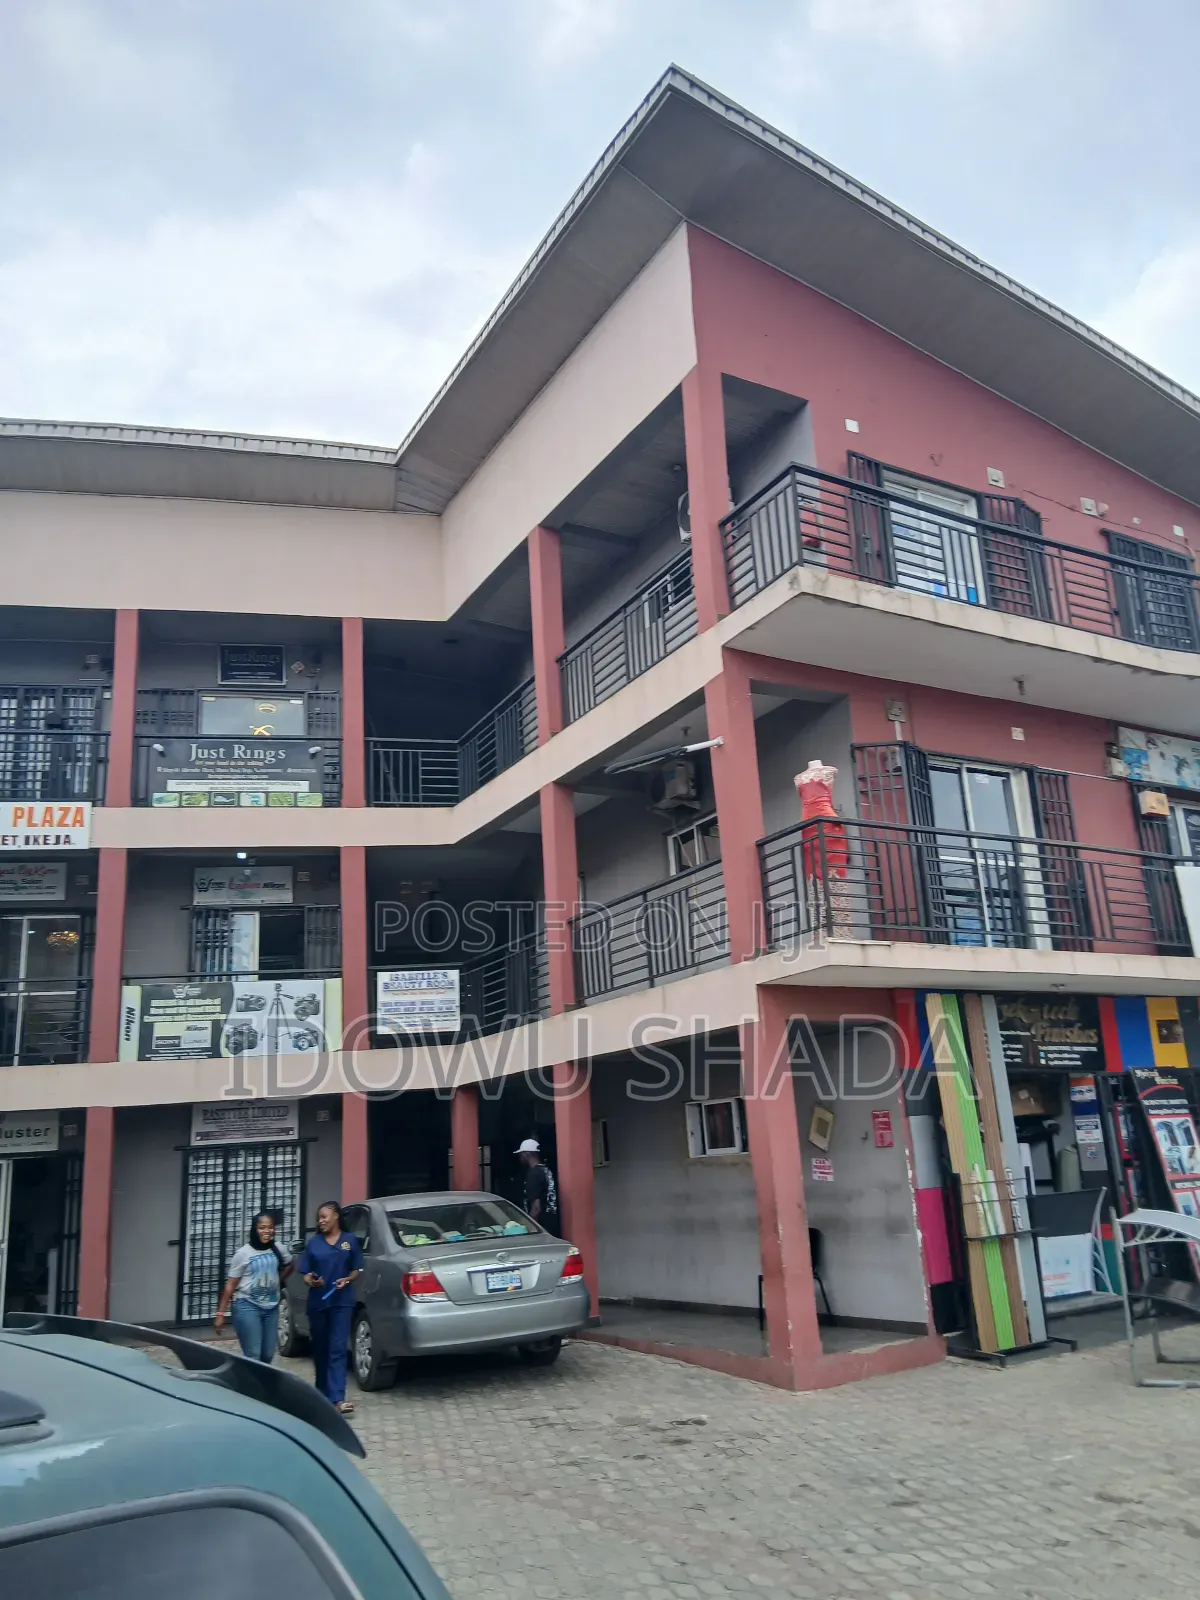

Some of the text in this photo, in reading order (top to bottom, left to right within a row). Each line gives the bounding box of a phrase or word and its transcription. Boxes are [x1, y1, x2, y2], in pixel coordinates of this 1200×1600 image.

[189, 743, 286, 764] Just Rings
[11, 806, 85, 828] PLAZA
[426, 979, 456, 989] ROOM
[124, 1005, 136, 1042] Nikon
